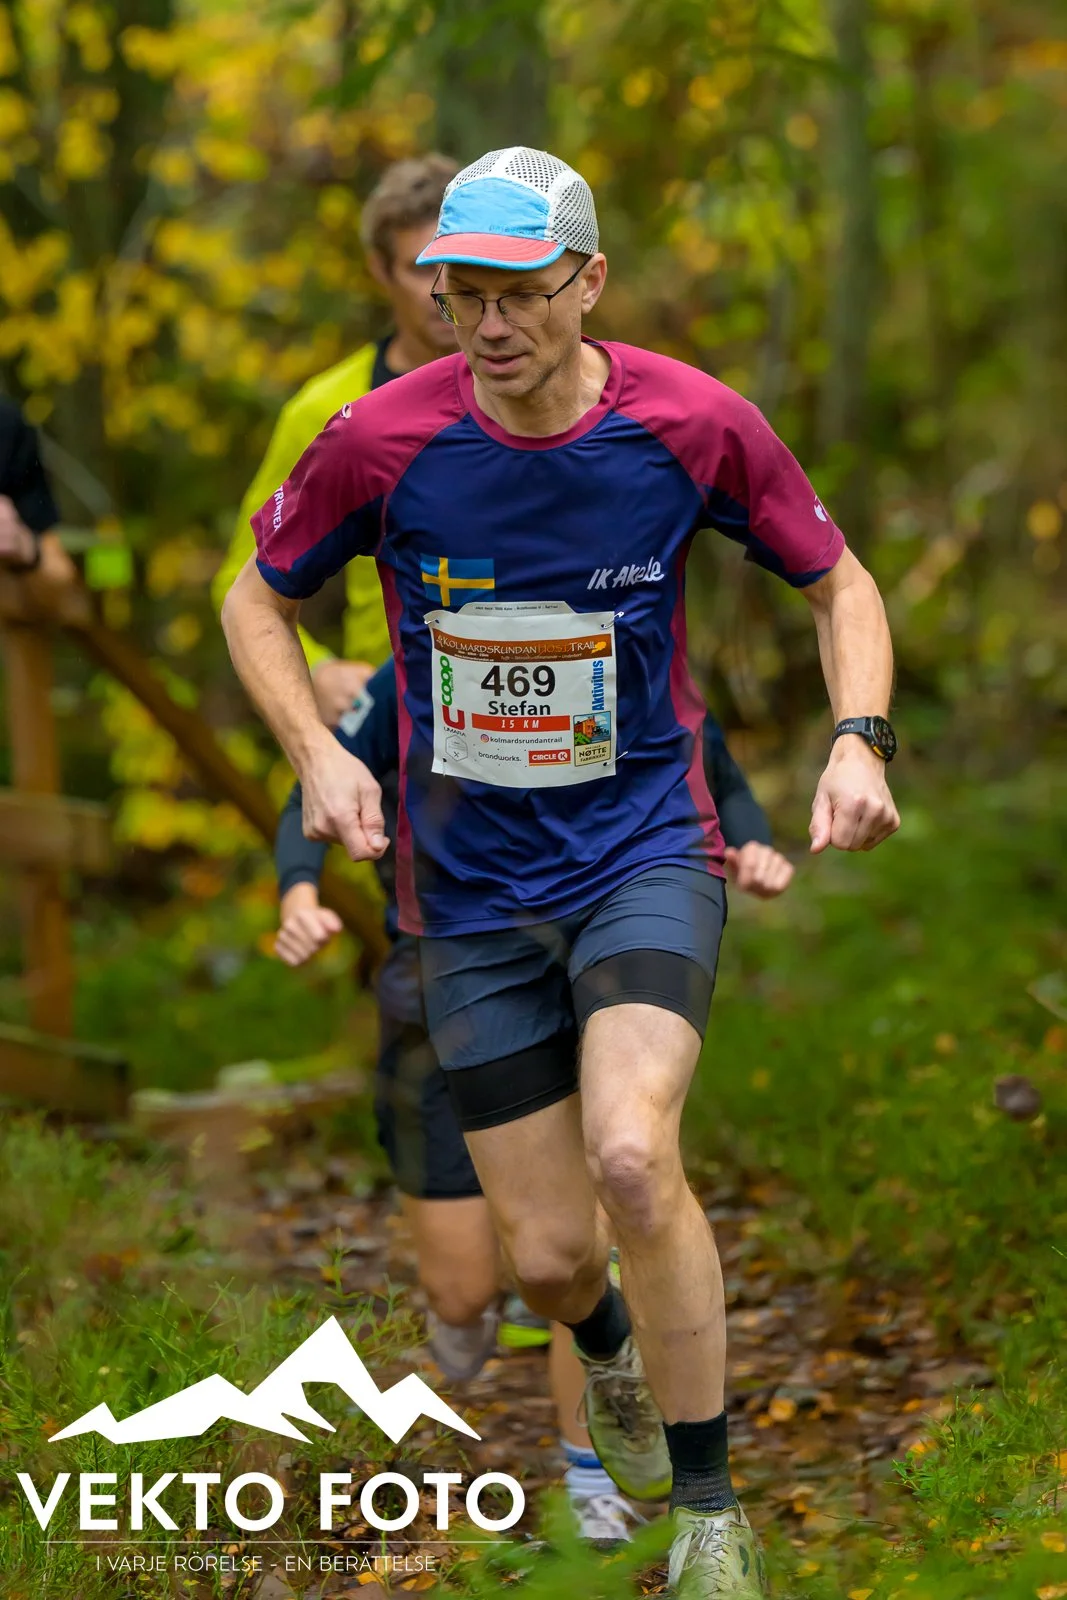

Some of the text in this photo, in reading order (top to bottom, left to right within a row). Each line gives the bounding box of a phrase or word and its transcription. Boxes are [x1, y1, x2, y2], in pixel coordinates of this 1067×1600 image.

[587, 556, 665, 590] IK Akele
[481, 665, 555, 697] 469
[592, 660, 605, 711] Aktivitus
[488, 700, 551, 715] Stefan
[501, 719, 539, 729] 15 KM
[490, 733, 563, 744] kolmardsrundantrail
[579, 747, 606, 757] NØTTE
